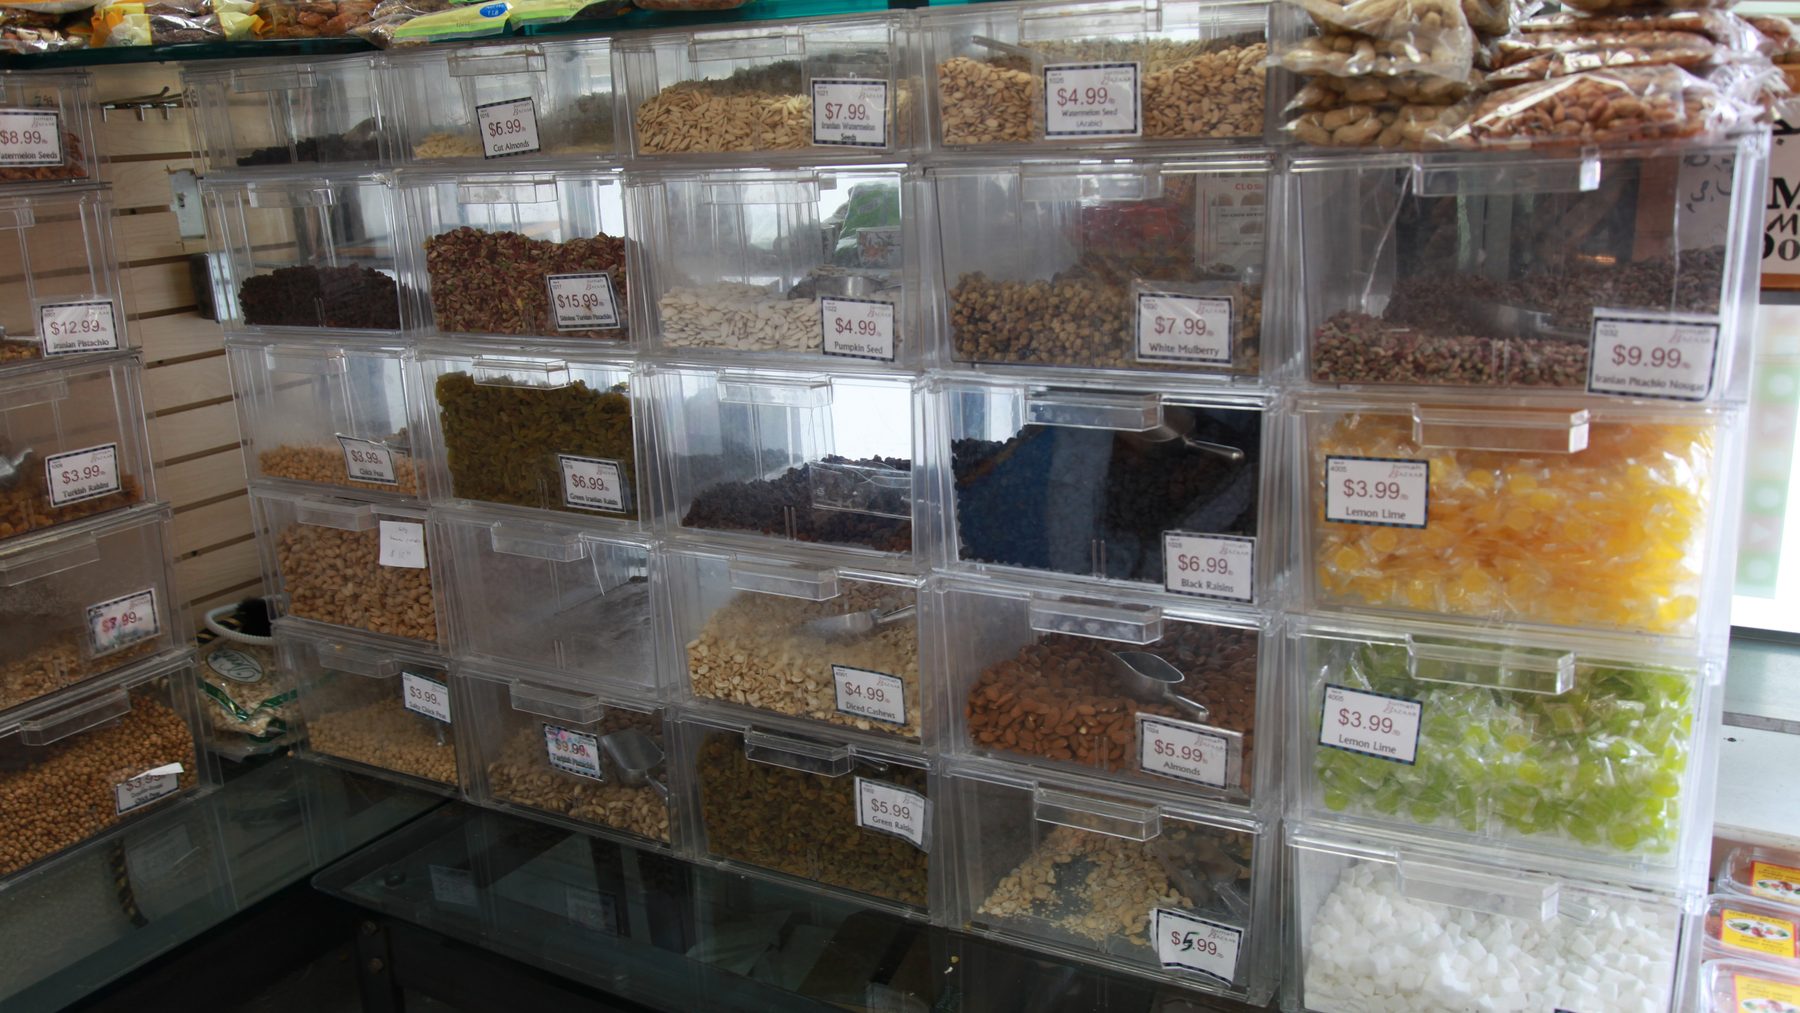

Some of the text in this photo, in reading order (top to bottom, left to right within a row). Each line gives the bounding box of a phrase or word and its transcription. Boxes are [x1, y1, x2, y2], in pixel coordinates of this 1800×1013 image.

[1057, 87, 1108, 107] $4.99
[825, 102, 866, 120] $7.99
[1062, 107, 1118, 117] Watermelon Seed
[0, 130, 41, 145] $8.99
[493, 140, 530, 152] Cut Almonds
[0, 151, 58, 160] atermelon Seeds
[557, 293, 599, 309] $15.99
[50, 319, 100, 336] $12.99
[835, 317, 876, 336] $4.99
[1154, 316, 1206, 335] $7.99
[77, 339, 110, 349] Pistachio
[834, 341, 883, 354] Pumpkin Seed
[1149, 343, 1219, 356] White Mulberry
[1612, 344, 1682, 369] $9.99
[1595, 374, 1626, 385] Iranian
[1669, 380, 1704, 393] Nougat
[351, 450, 379, 464] $3.99
[62, 464, 100, 485] $3.99
[571, 473, 604, 491] $6.99
[62, 486, 87, 498] Turkish
[1343, 478, 1400, 499] $3.99
[1345, 506, 1407, 521] Lemon Lime
[1178, 553, 1228, 575] $6.99
[1181, 578, 1235, 593] Black Raisins
[410, 685, 437, 705] $3.99
[845, 681, 884, 703] $4.99
[846, 701, 896, 719] Diced Cashews
[1338, 708, 1393, 734] $3.99
[555, 738, 586, 756] $9.99
[1154, 739, 1203, 763] $5.99
[1338, 734, 1397, 754] Lemon Lime
[1163, 761, 1201, 776] Almonds
[871, 798, 910, 819] $5.99
[872, 815, 915, 835] Green Raisins
[1171, 931, 1217, 955] $5.99
